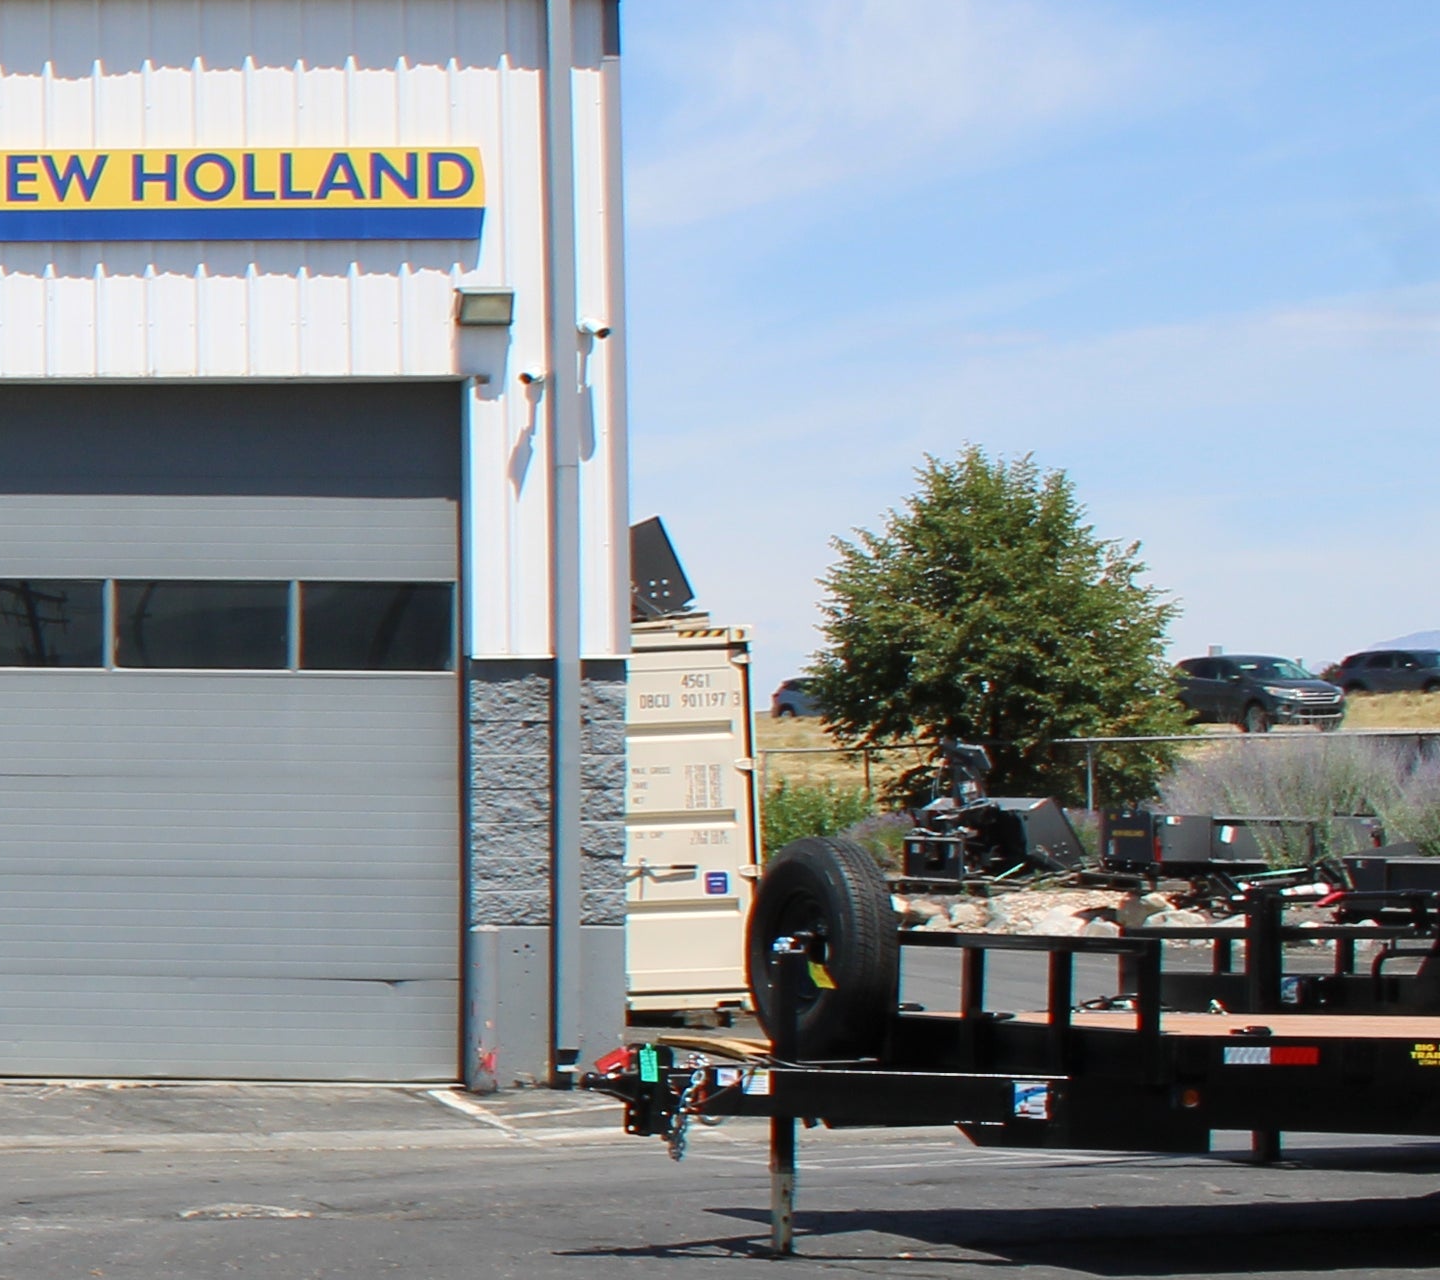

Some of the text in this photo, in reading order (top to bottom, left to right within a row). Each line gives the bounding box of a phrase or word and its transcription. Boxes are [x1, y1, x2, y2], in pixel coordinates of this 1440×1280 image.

[131, 152, 475, 201] HOLLAND
[681, 674, 710, 688] 45G1
[681, 692, 726, 708] 901197
